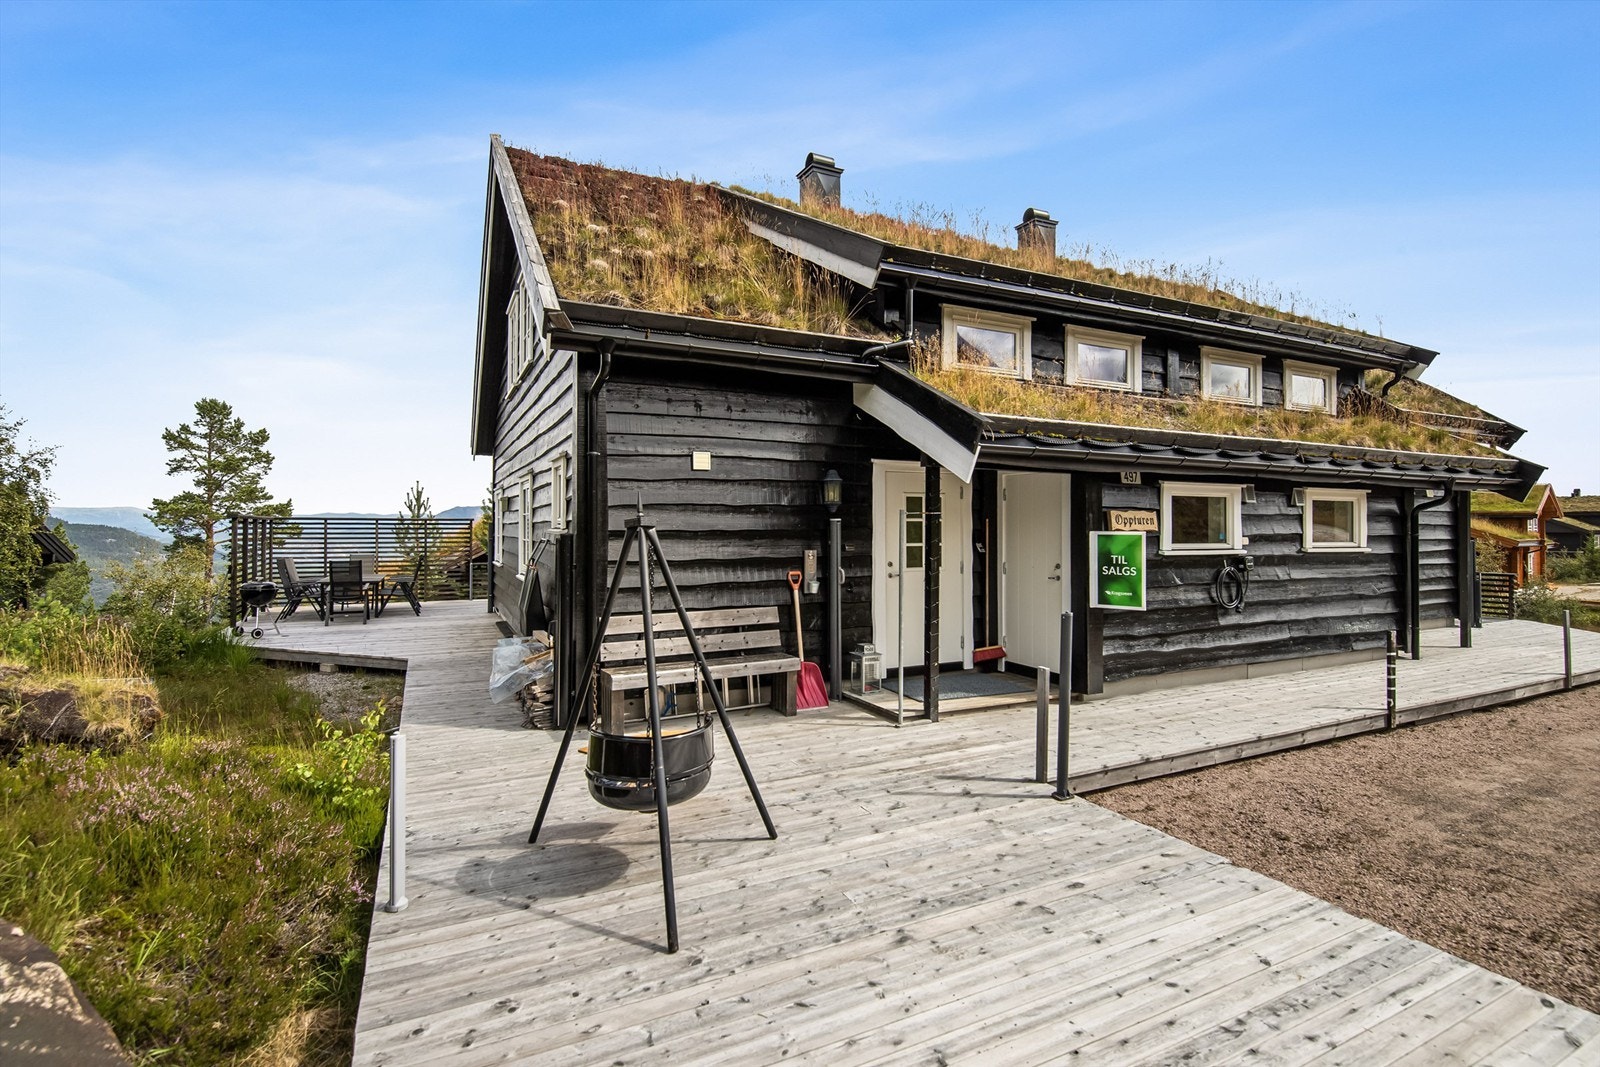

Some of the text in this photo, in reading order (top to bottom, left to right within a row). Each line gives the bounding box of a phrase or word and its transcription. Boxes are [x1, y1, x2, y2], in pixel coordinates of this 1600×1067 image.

[1123, 472, 1138, 483] 497
[1115, 513, 1155, 528] Oppturen
[1111, 555, 1127, 564] TIL
[1102, 565, 1137, 576] SALGS
